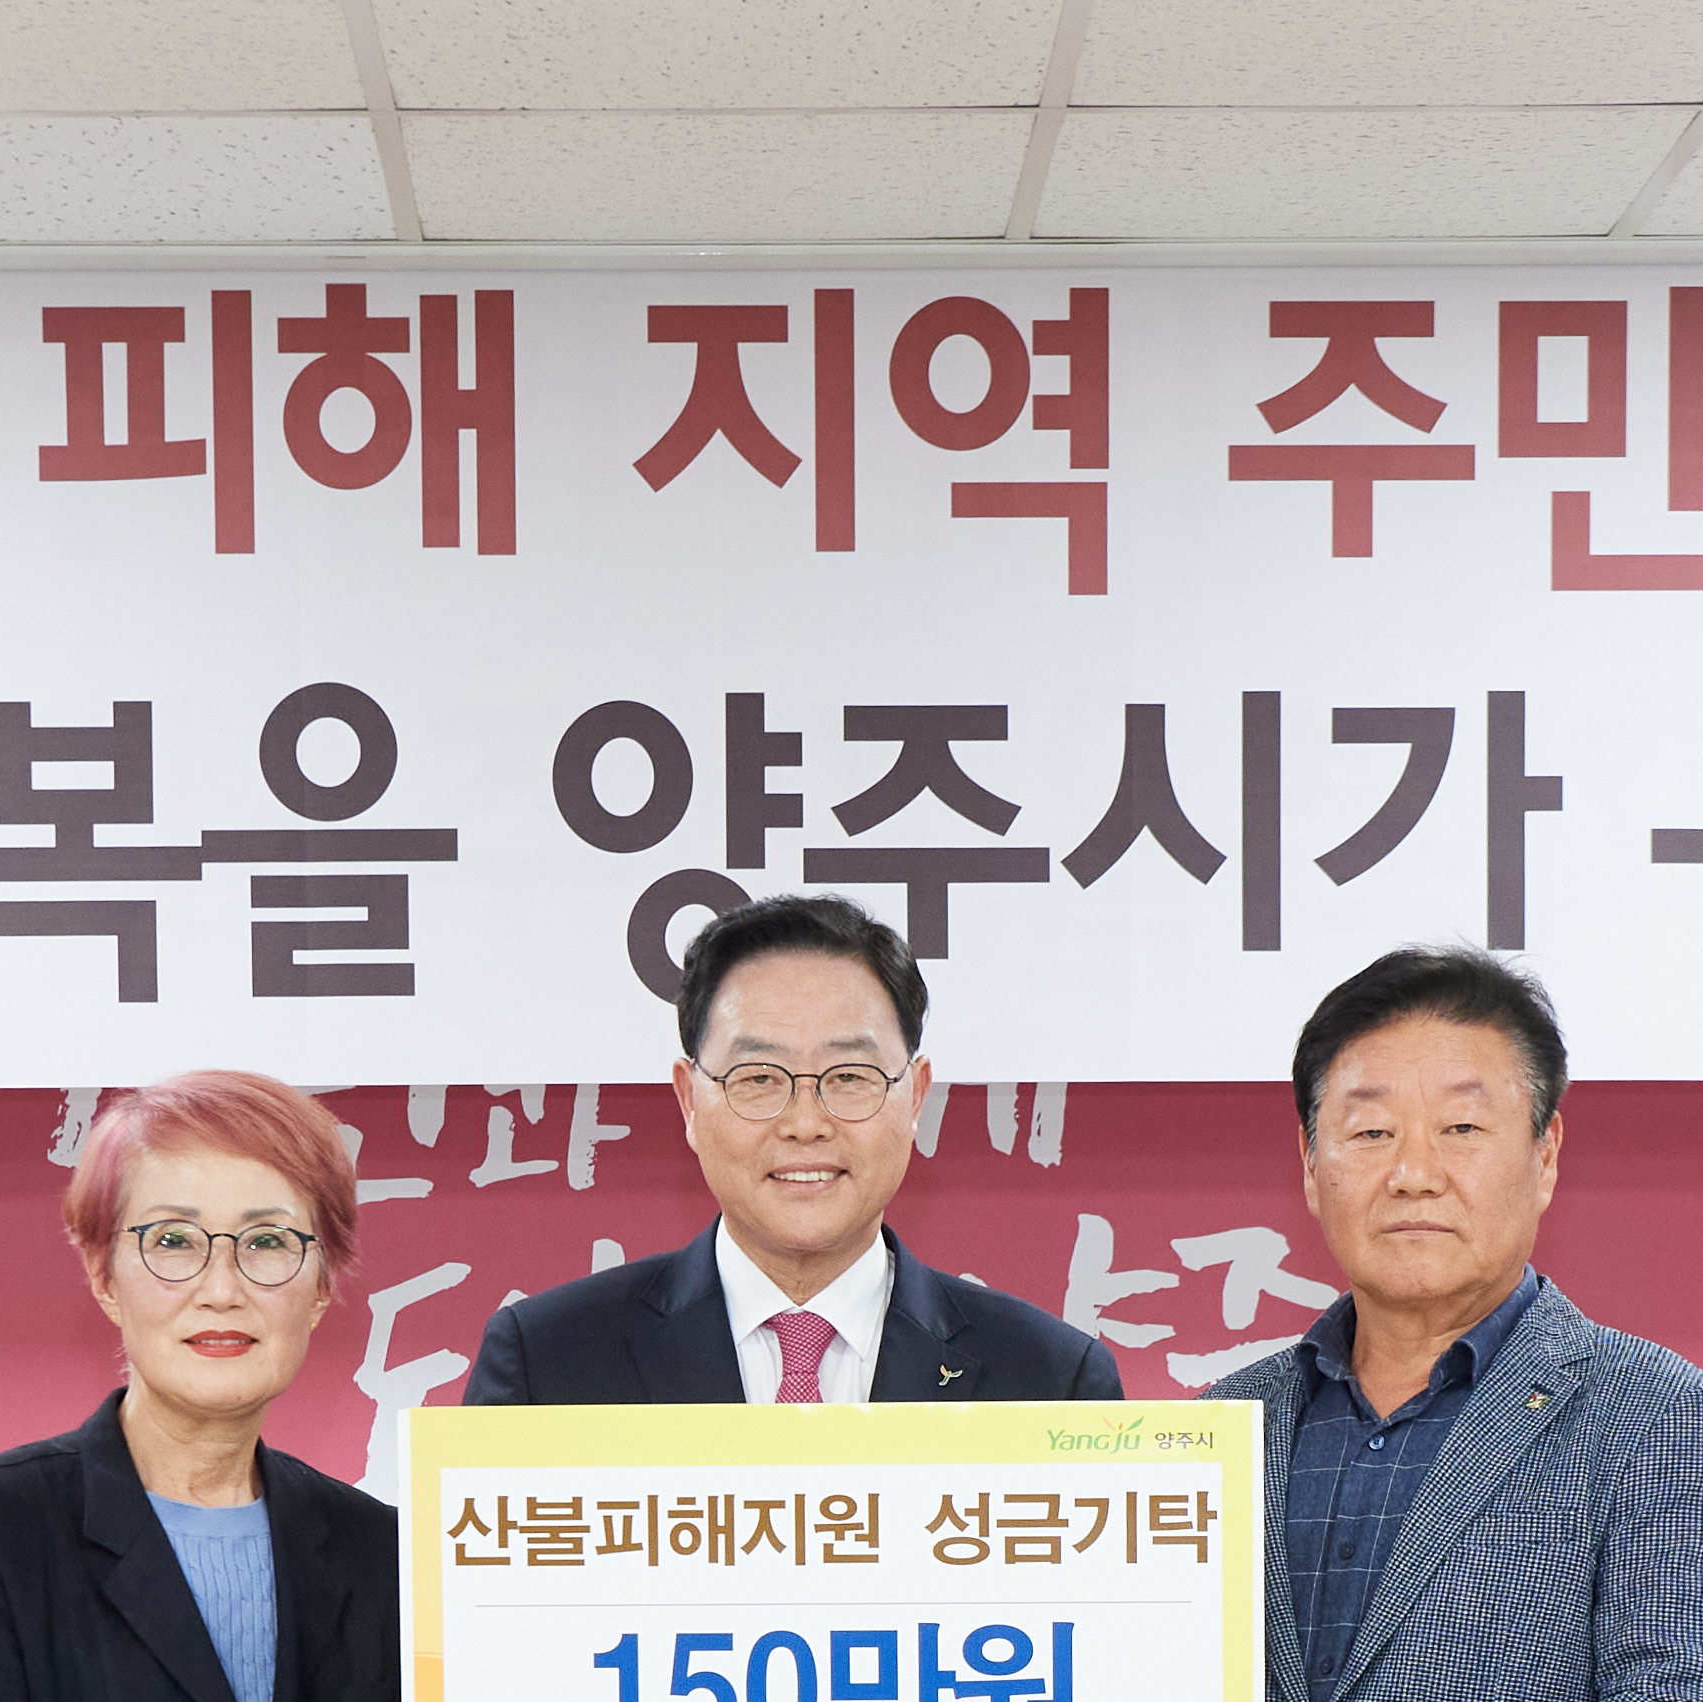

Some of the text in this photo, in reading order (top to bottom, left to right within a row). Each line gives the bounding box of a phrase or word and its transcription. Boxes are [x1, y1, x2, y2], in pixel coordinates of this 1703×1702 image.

[39, 283, 516, 555] 피해
[633, 286, 1110, 595] 지역
[552, 691, 1562, 1006] 양주시가
[448, 1492, 1217, 1566] 산불피해지원 성금기탁
[1155, 1431, 1213, 1450] 양주시
